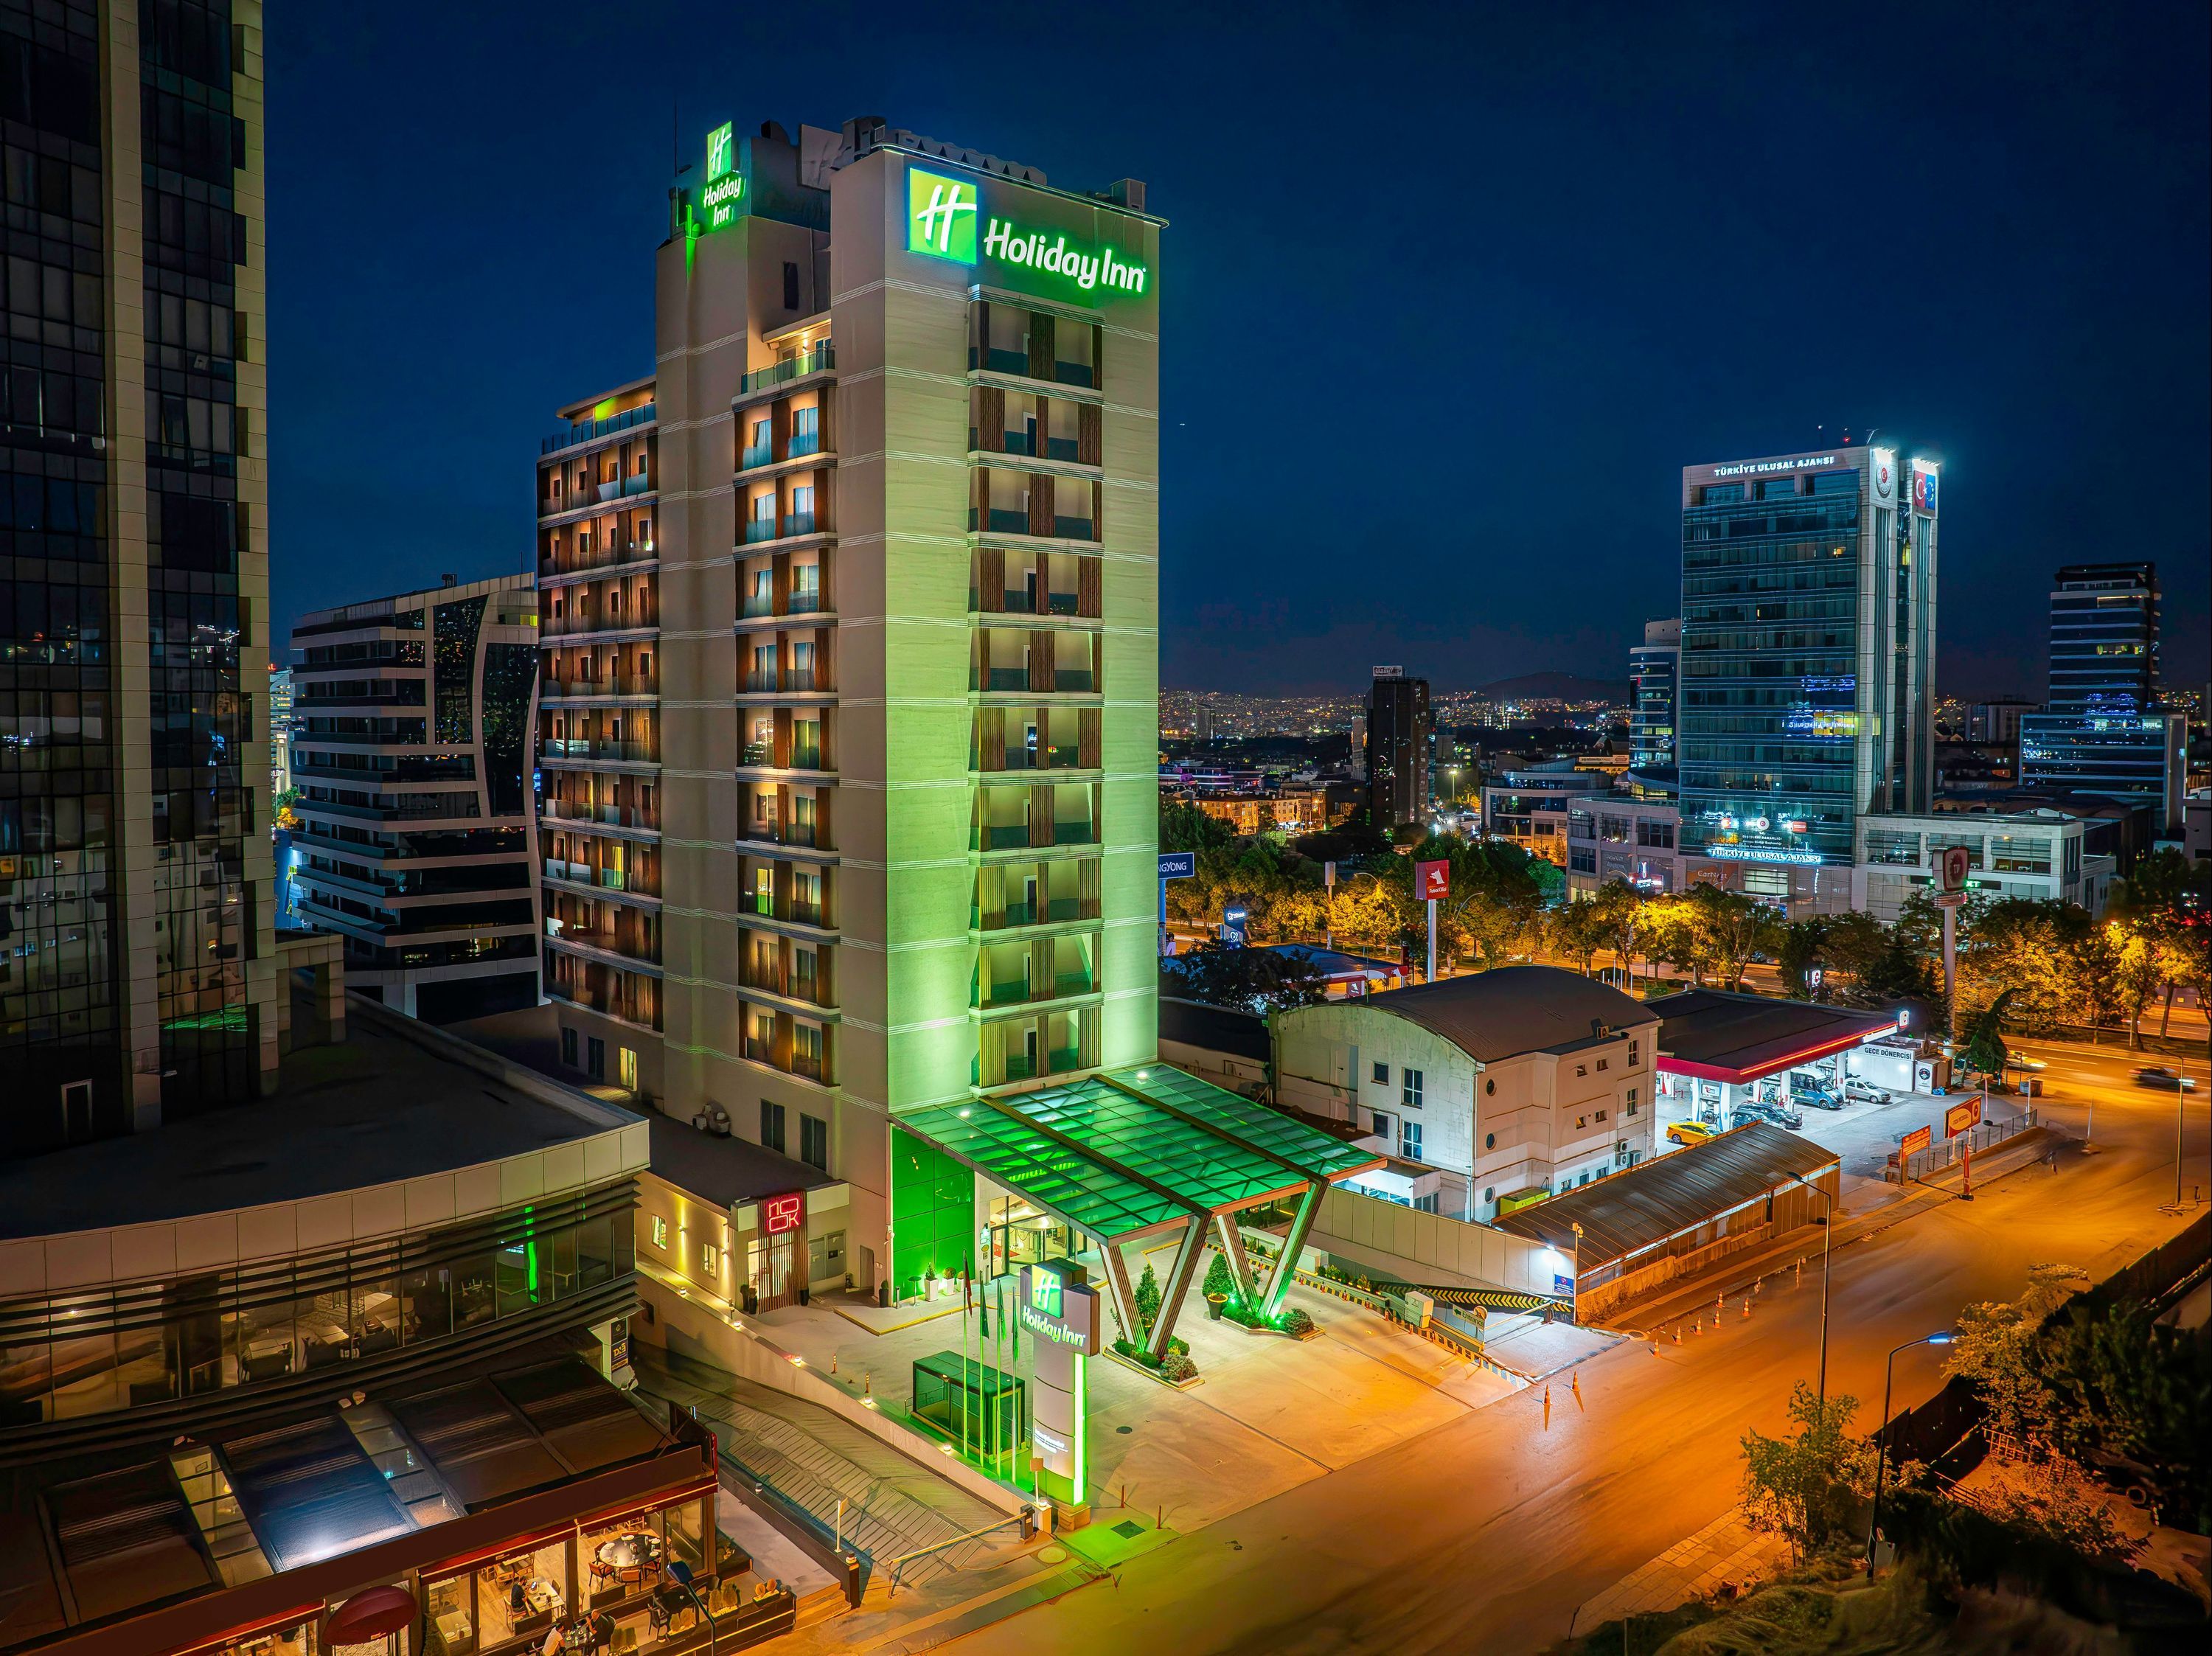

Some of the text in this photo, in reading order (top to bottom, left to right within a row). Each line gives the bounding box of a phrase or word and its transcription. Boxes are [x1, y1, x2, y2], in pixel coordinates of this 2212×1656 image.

[703, 177, 741, 208] Holiday
[714, 205, 730, 226] Inn
[984, 218, 1144, 293] Holiday Inn
[1714, 456, 1834, 476] TÜRKİYE ULUSAL AJANSI
[1710, 846, 1820, 863] TÜRKİYE ULUSAL AJANSI
[1864, 1047, 1912, 1060] GECE DÖNERCİSİ
[1022, 1304, 1084, 1347] Holiday Inn
[1462, 1310, 1485, 1327] Entrance
